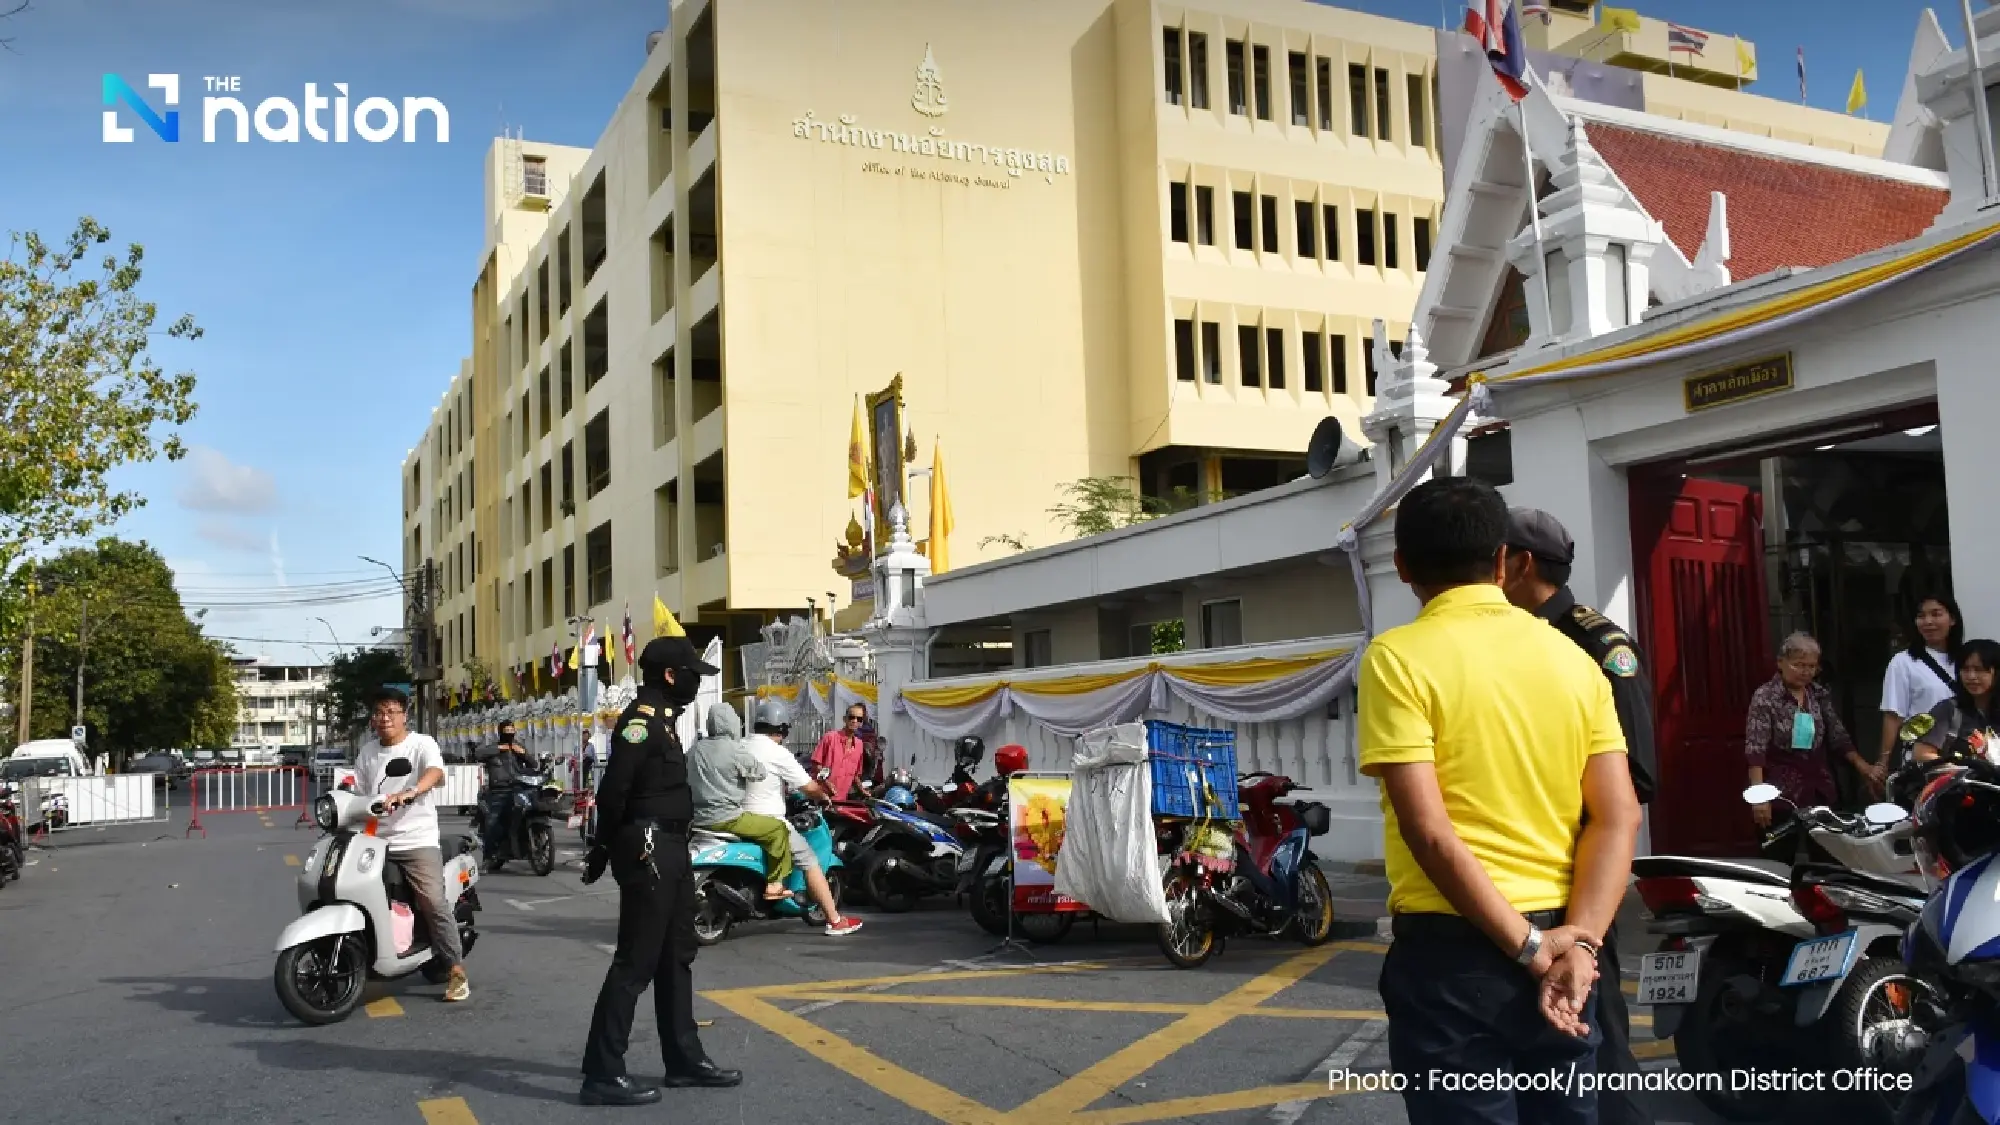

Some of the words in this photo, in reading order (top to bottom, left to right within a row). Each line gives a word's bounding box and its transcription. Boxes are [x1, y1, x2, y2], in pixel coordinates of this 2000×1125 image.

[791, 108, 1070, 185] สำนักงานอัยการสูงสุด
[861, 160, 890, 176] Office
[1693, 366, 1778, 398] ศาลหลักเมือง
[1648, 985, 1686, 1001] 1924
